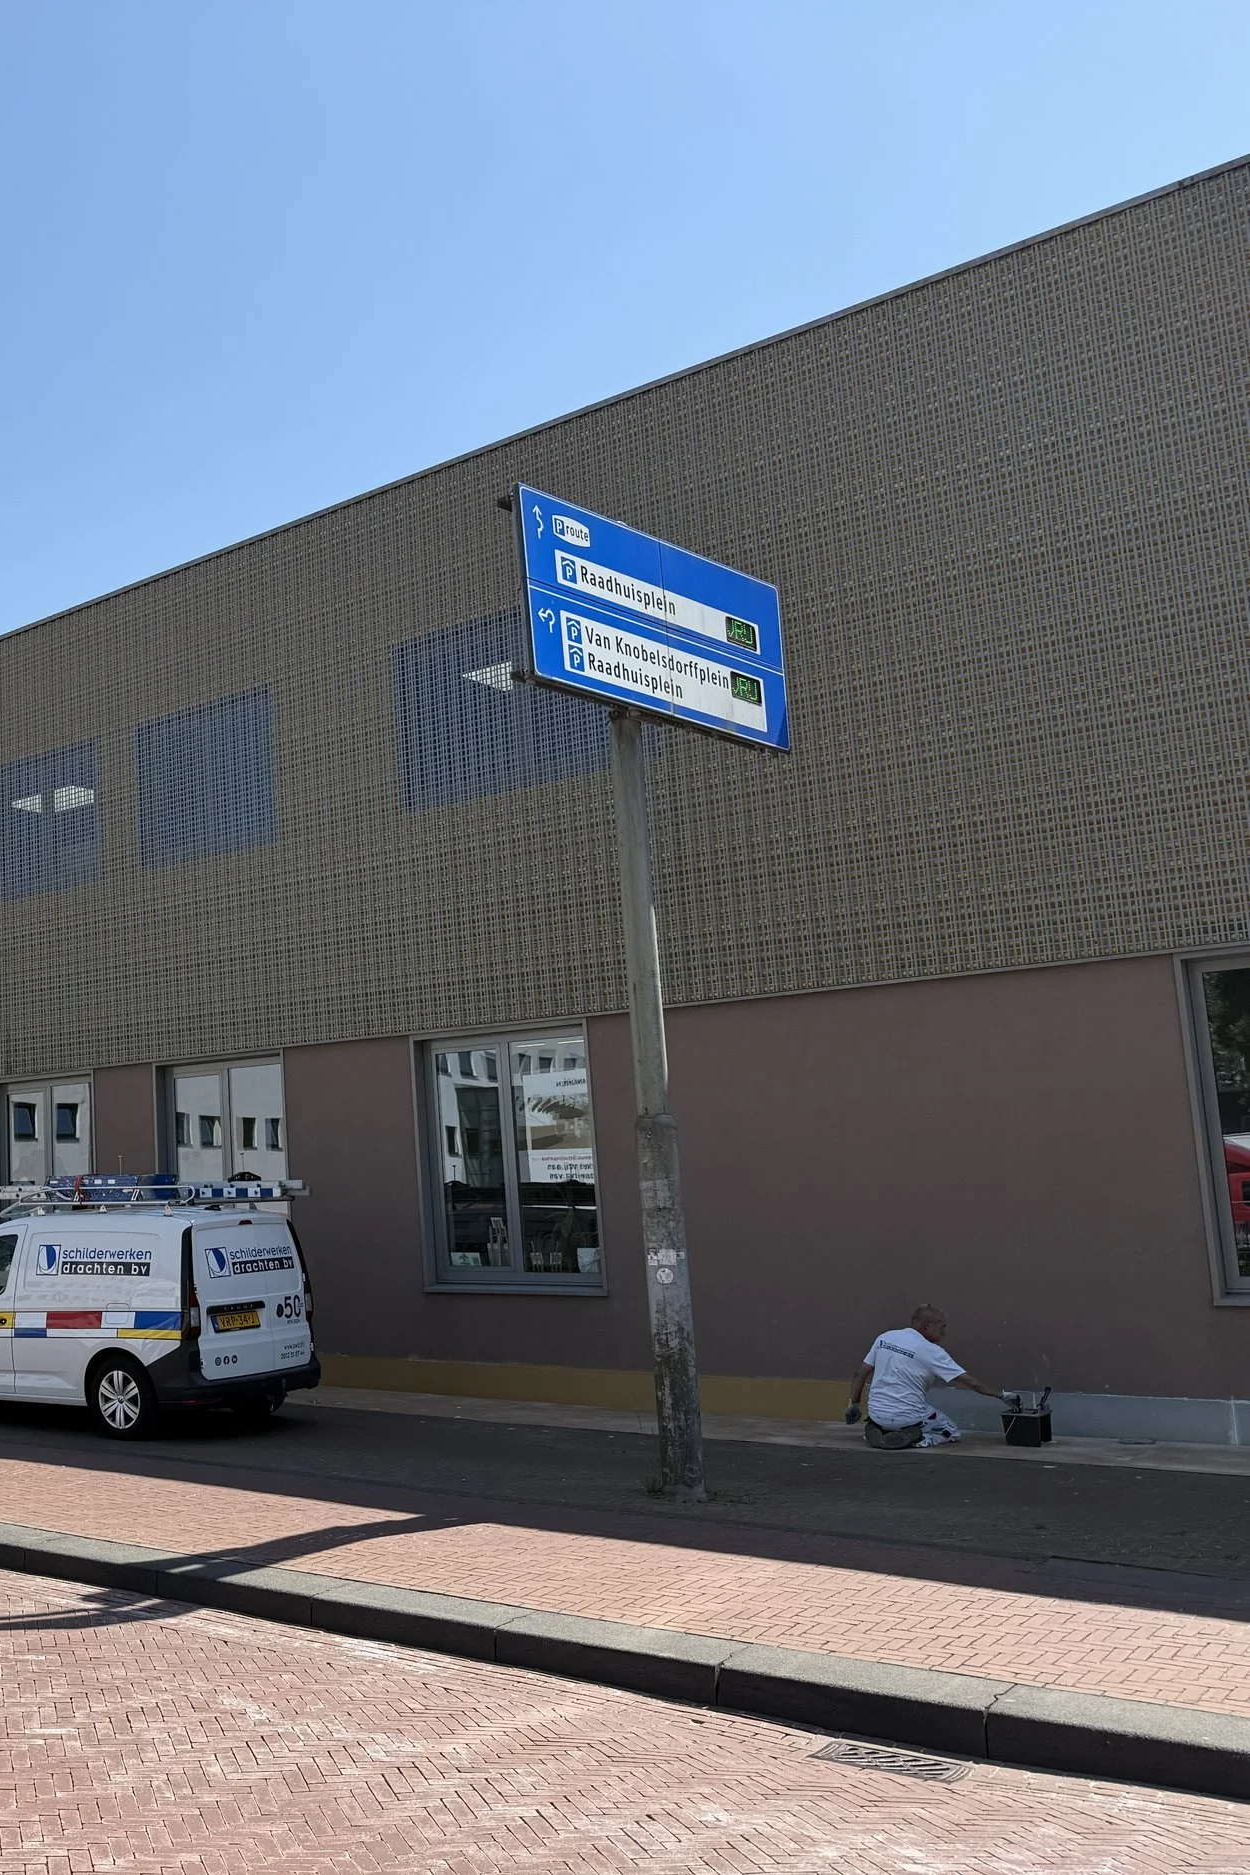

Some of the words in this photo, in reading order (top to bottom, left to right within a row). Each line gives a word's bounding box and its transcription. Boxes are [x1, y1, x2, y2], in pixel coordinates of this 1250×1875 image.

[566, 524, 589, 542] route
[580, 565, 676, 616] Raadhuisplein
[585, 625, 610, 650] Van
[615, 635, 729, 689] Knobelsdorffplein
[588, 652, 683, 699] Raadhuisplein
[62, 1247, 152, 1260] schilderwerken
[230, 1245, 292, 1260] schilderwerken
[62, 1263, 124, 1274] drachten
[131, 1263, 147, 1275] bv
[233, 1260, 280, 1274] drachten
[283, 1258, 293, 1268] bv
[284, 1295, 301, 1319] 50
[220, 1313, 256, 1328] VRP-34-J
